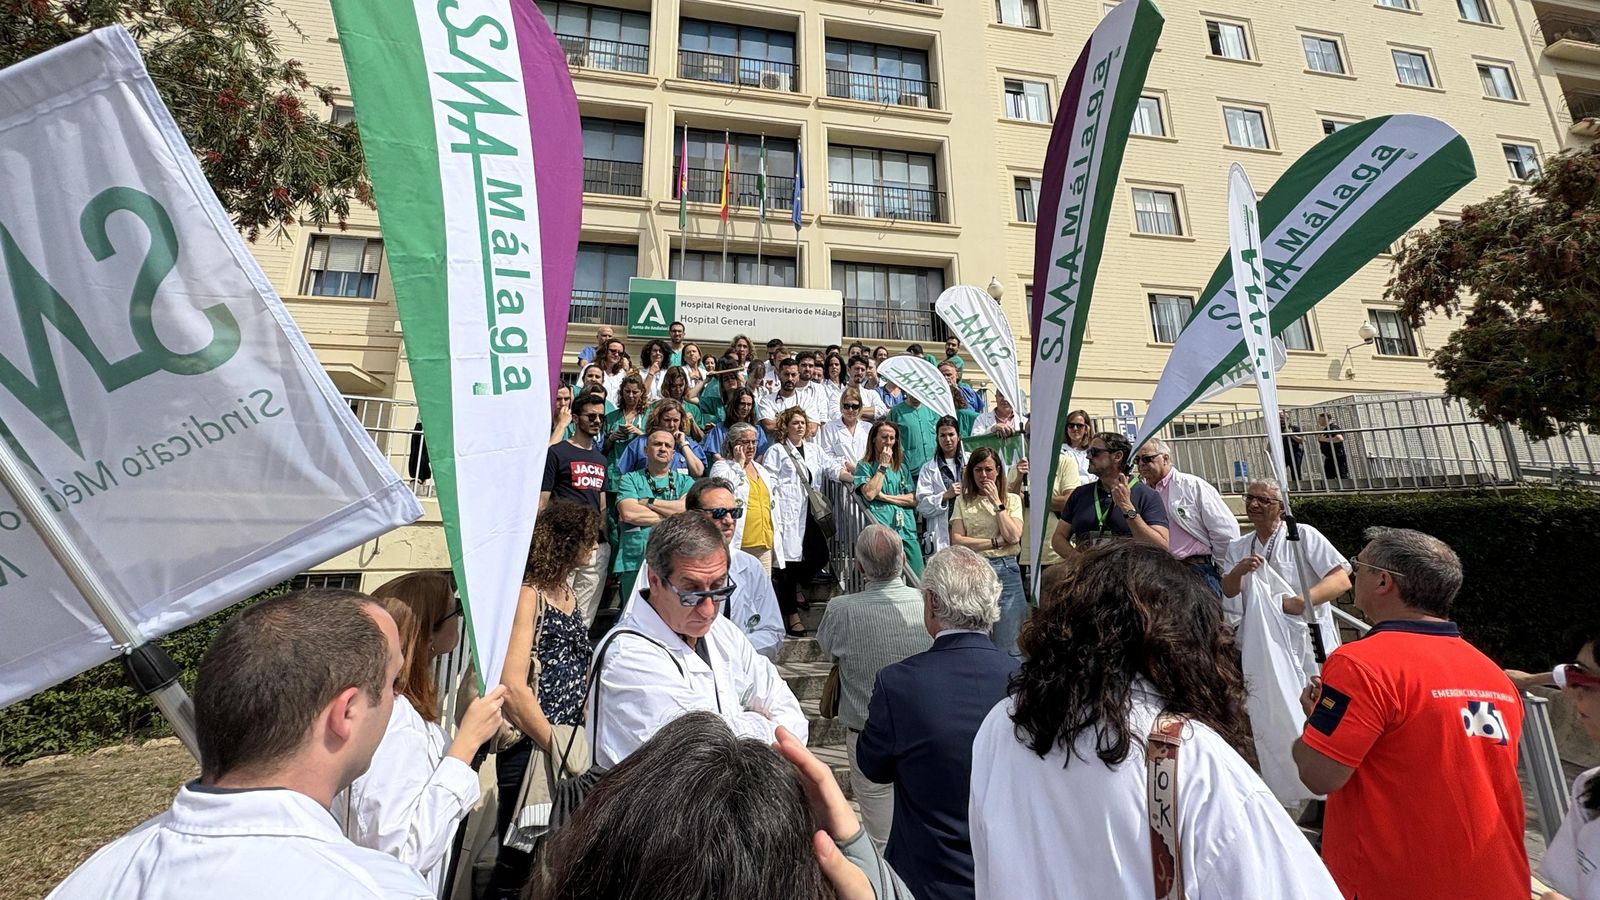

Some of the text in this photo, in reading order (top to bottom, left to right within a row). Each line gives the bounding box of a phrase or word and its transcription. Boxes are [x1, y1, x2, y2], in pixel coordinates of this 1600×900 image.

[1060, 57, 1109, 238] Málaga
[1275, 144, 1398, 252] Málaga
[486, 177, 533, 392] Málaga
[680, 300, 715, 311] Hospital
[716, 302, 751, 313] Regional
[752, 304, 803, 315] Universitario
[814, 308, 842, 318] Málaga
[680, 314, 756, 327] Hospital General
[574, 476, 604, 489] JONE
